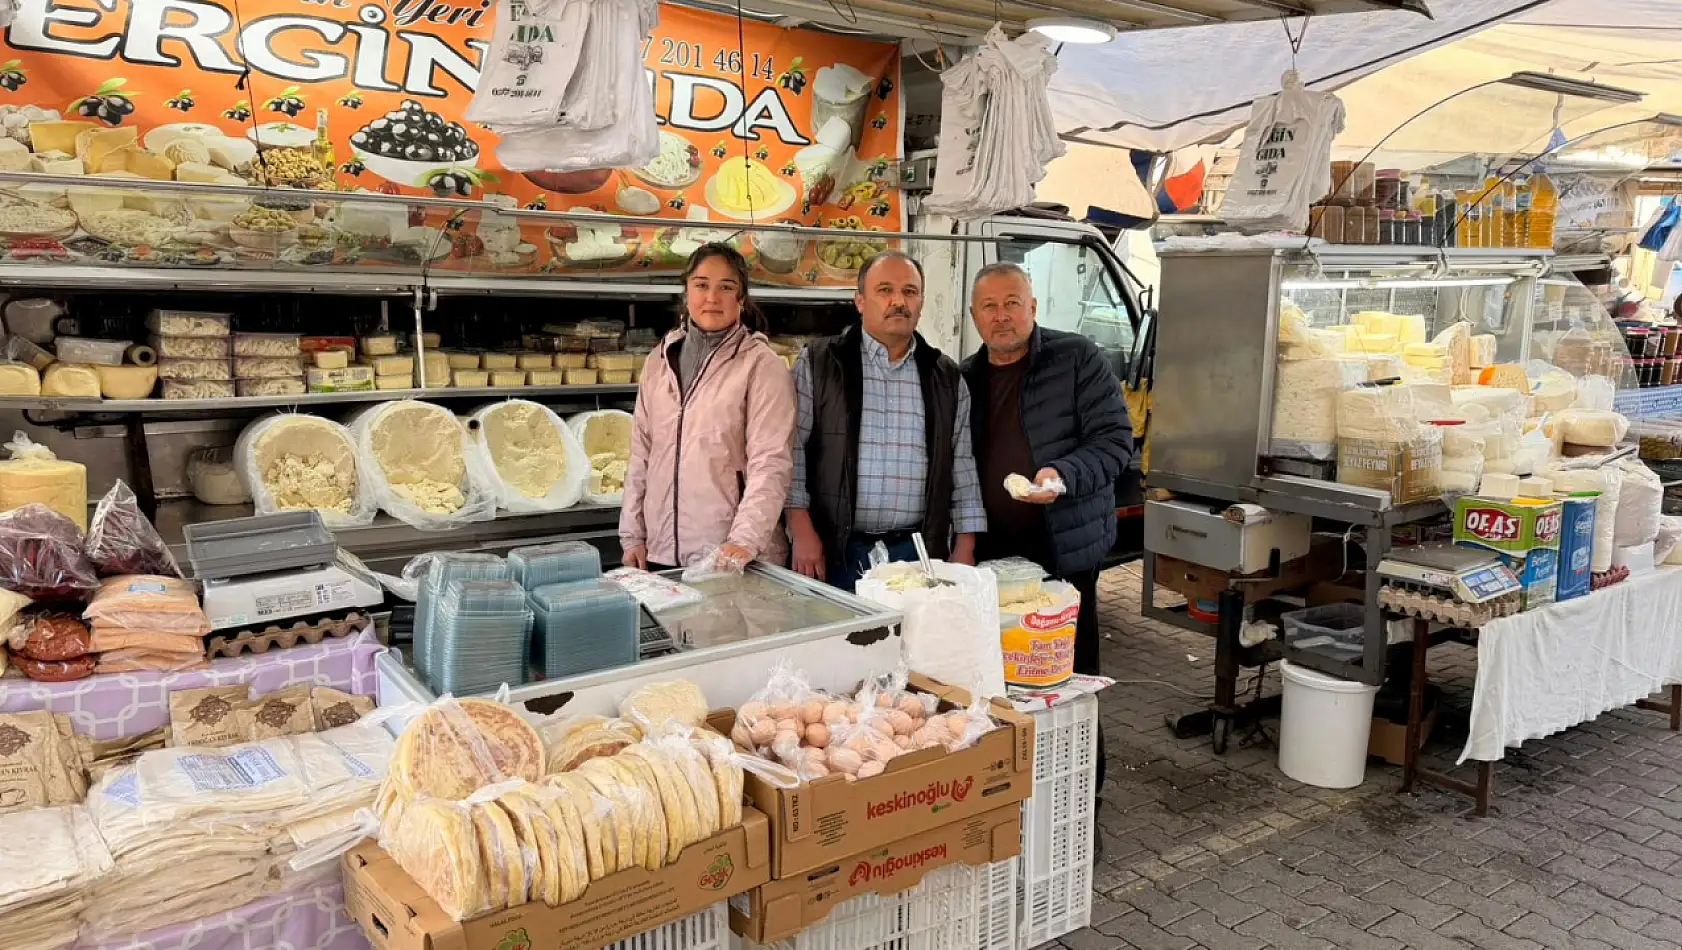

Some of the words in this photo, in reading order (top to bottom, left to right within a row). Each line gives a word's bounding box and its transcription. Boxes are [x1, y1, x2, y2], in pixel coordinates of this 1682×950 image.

[393, 0, 490, 26] Yeri
[510, 25, 554, 42] IDA
[660, 38, 702, 68] 201
[713, 48, 742, 74] 46
[752, 53, 773, 80] 14
[645, 67, 811, 145] DA
[1256, 148, 1285, 161] GIDA
[866, 780, 950, 820] keskinoğlu
[872, 842, 947, 880] keskinoğlu
